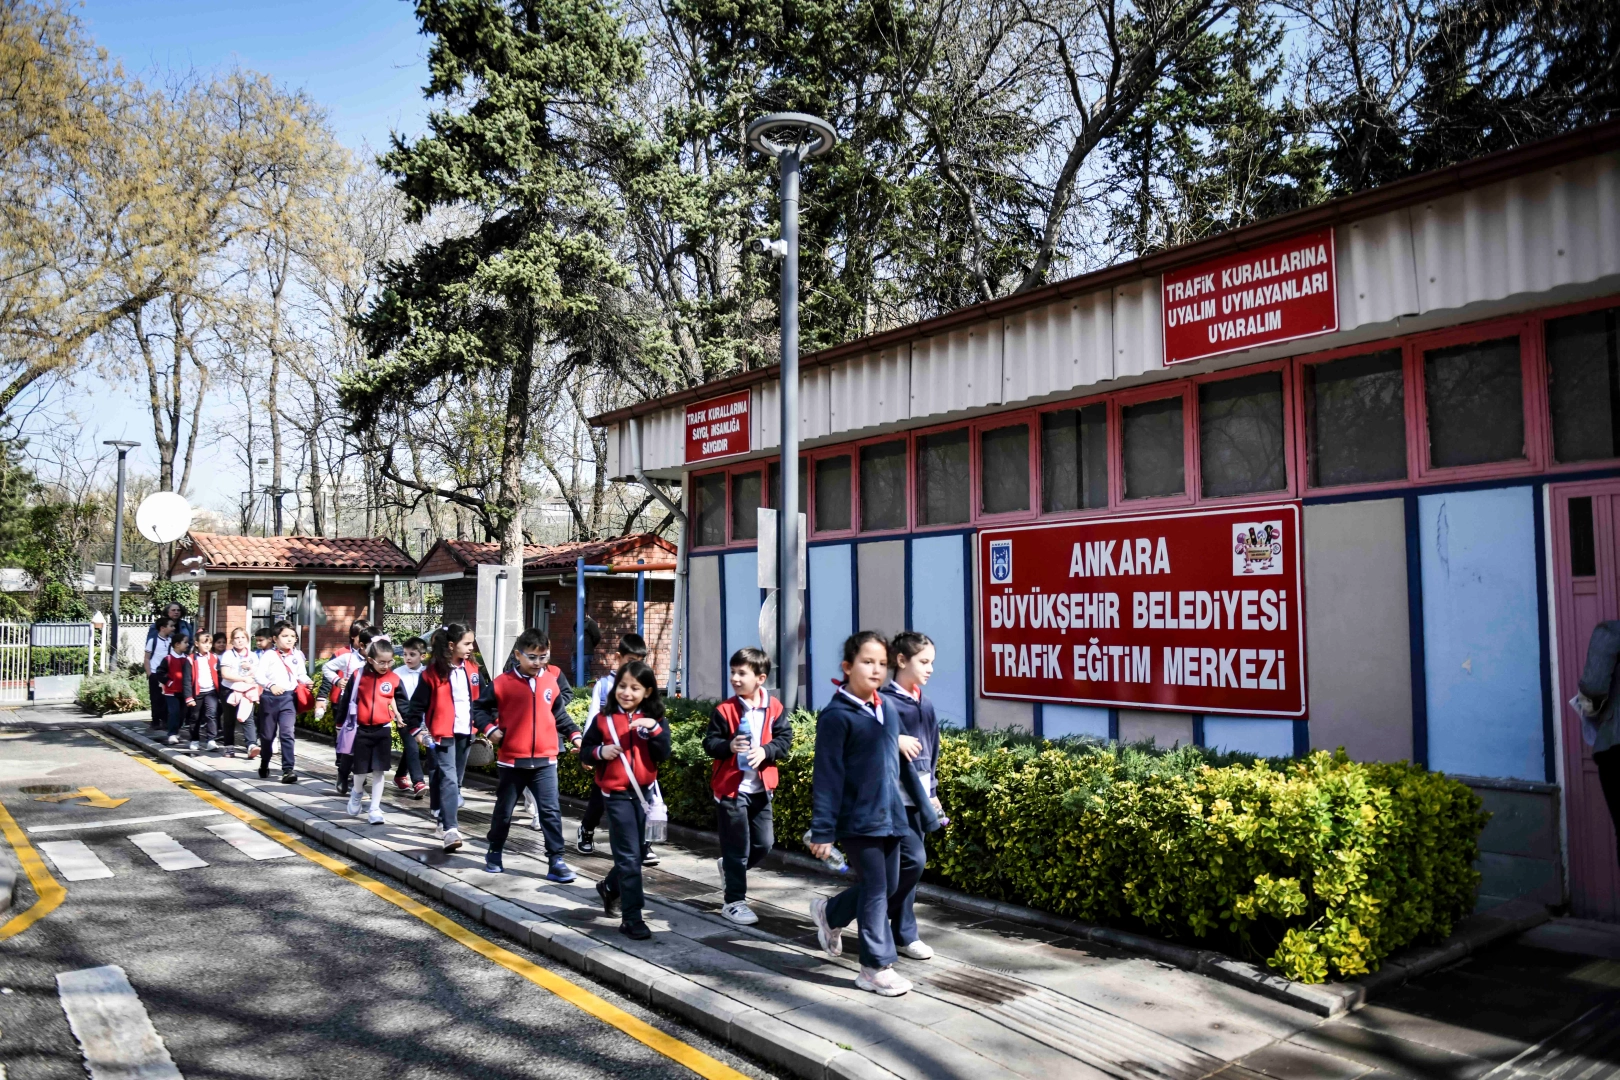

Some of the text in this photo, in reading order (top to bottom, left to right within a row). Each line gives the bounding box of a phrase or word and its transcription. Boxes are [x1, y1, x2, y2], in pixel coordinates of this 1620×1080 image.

[1222, 244, 1327, 289] KURALLARINA
[1168, 271, 1328, 327] UYALIM UYMAYANLARI
[1208, 310, 1281, 344] UYARALIM
[708, 400, 747, 421] KURALLARINA
[702, 438, 728, 454] SAYGIDIR
[1068, 536, 1171, 578] ANKARA
